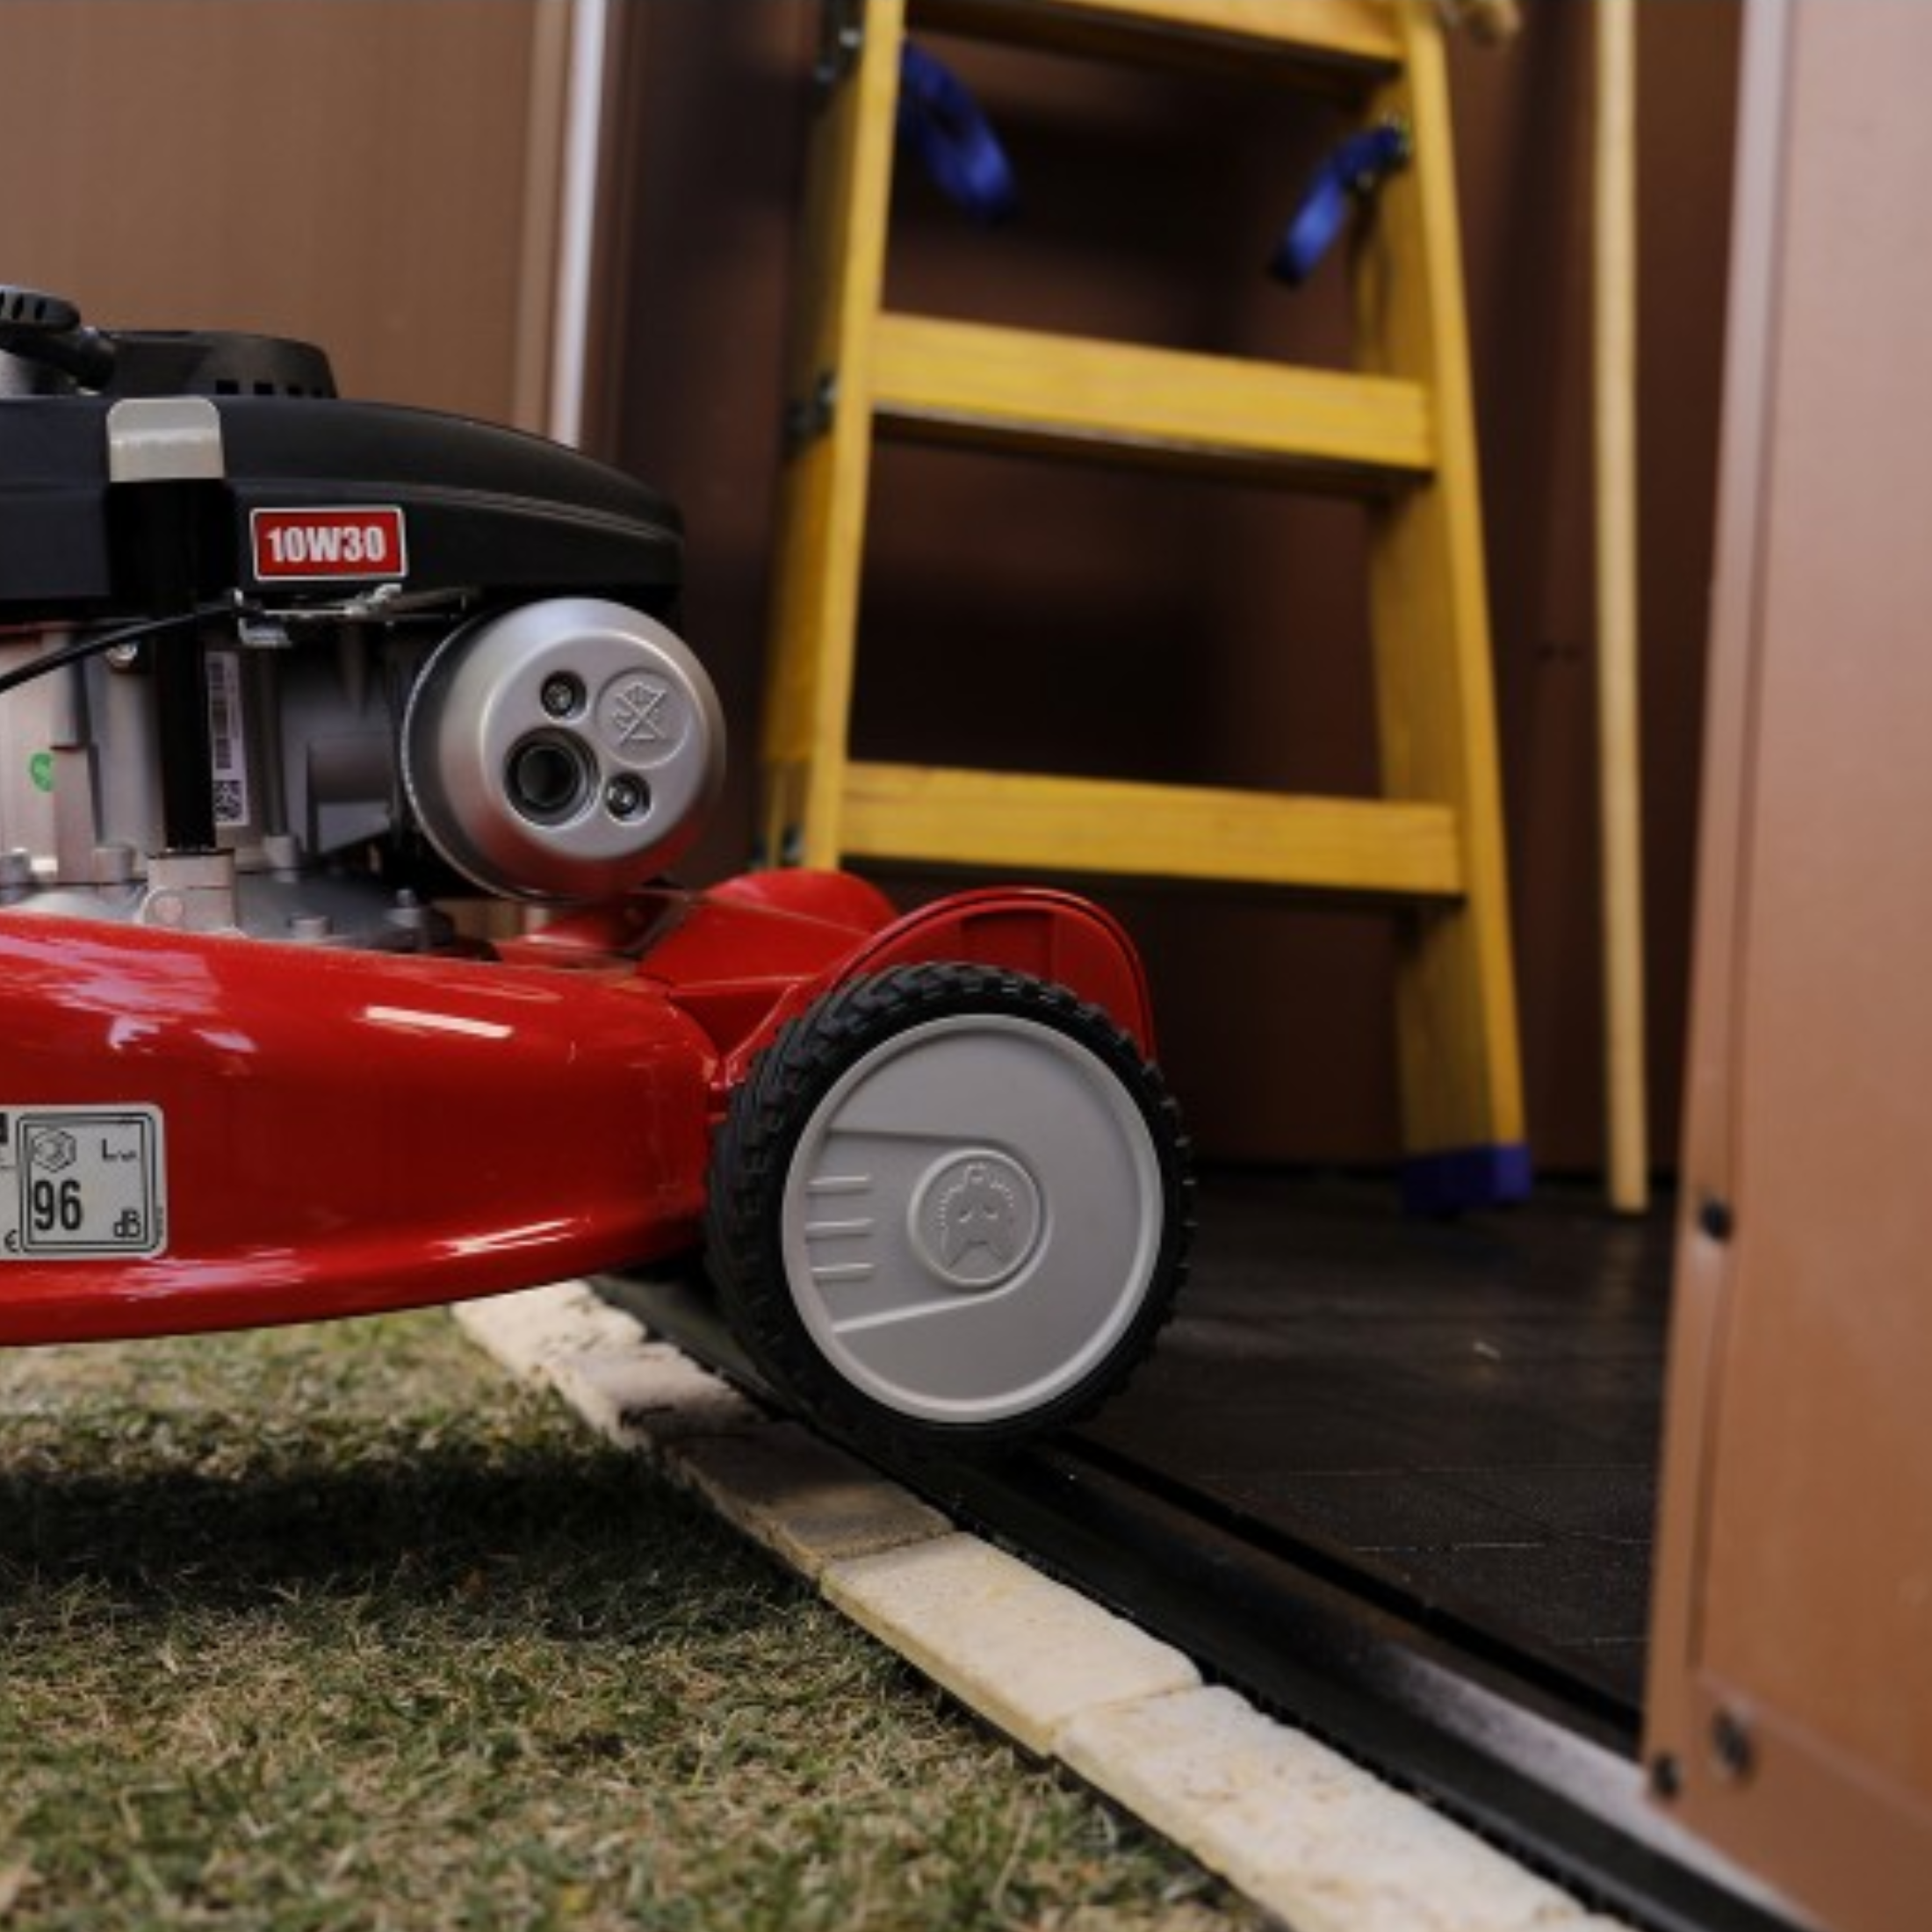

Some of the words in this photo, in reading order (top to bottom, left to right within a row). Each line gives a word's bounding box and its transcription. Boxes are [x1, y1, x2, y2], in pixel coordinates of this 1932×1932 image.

[267, 526, 386, 563] 10W30
[34, 1179, 83, 1231] 96
[113, 1208, 141, 1237] dB
